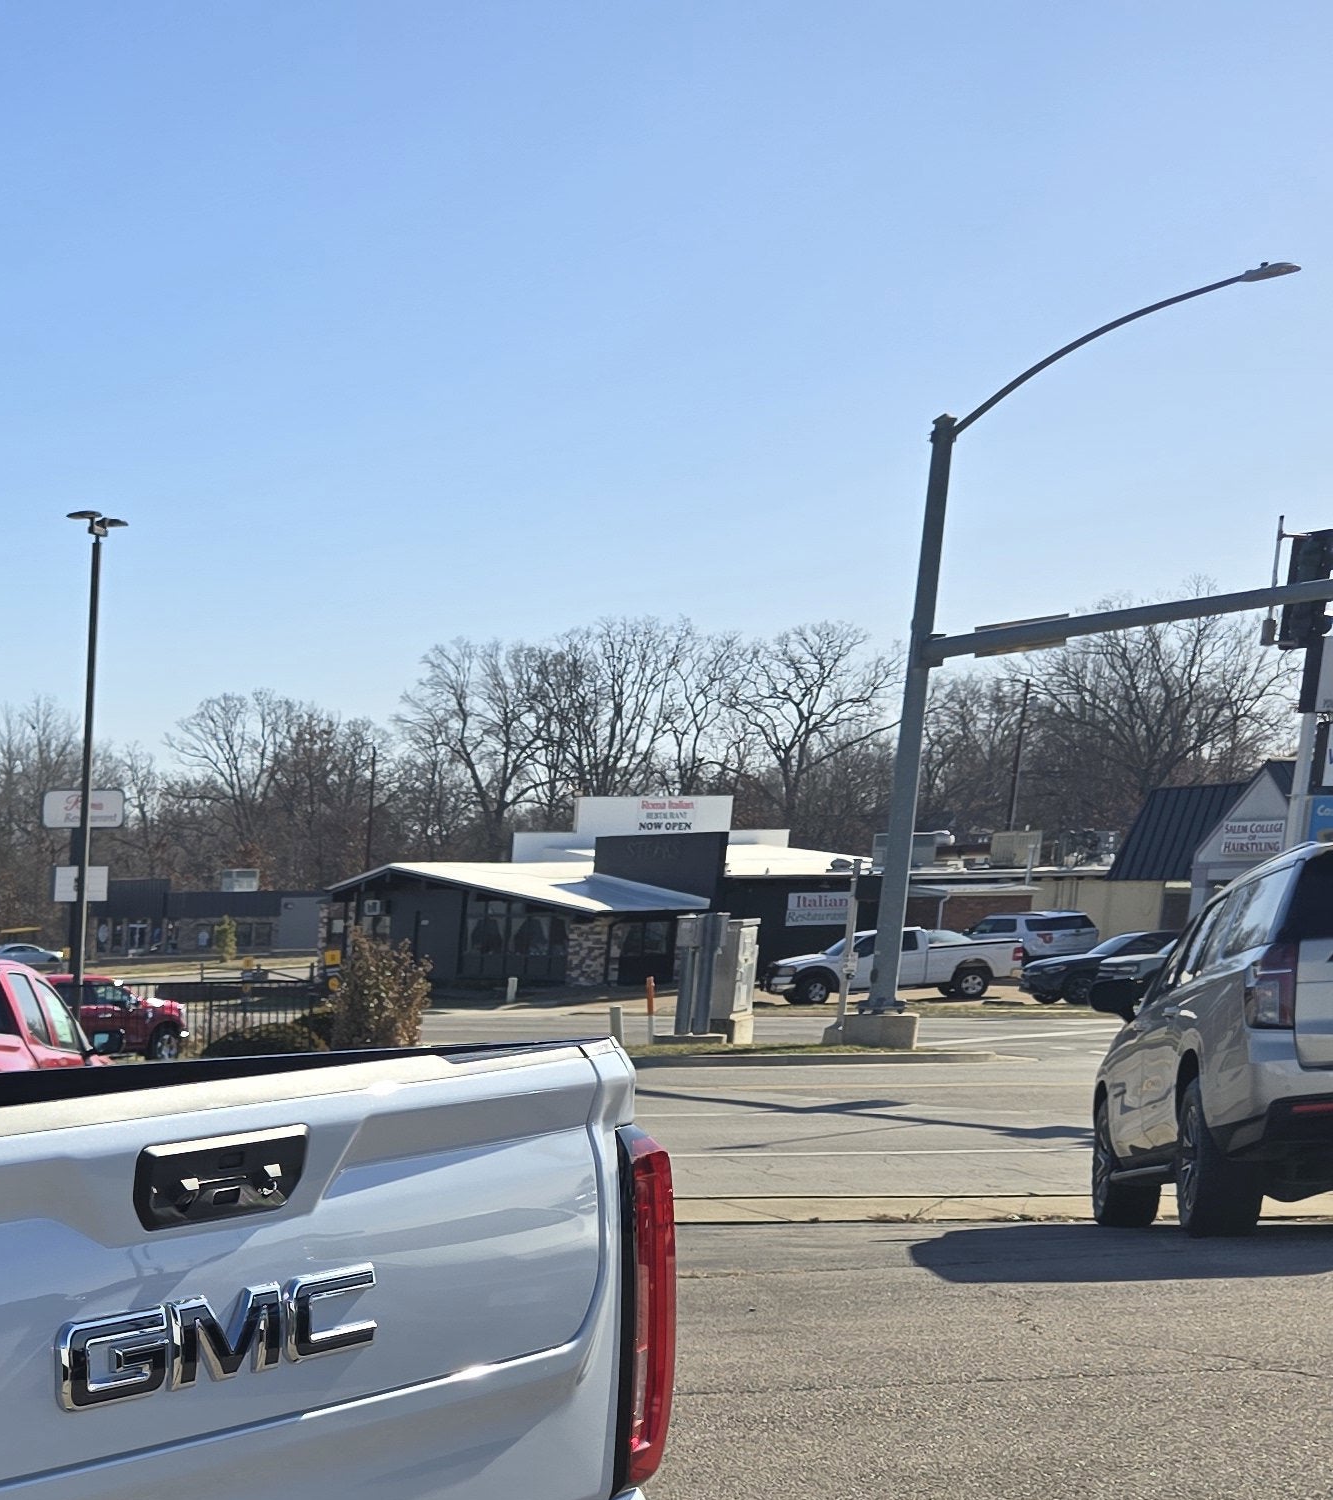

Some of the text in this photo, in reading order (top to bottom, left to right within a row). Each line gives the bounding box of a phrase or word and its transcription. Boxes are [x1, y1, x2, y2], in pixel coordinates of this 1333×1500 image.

[638, 822, 693, 831] NOW OPEN
[1224, 822, 1283, 834] SALEM COLLEGE
[1223, 841, 1280, 853] HAIRSTYLING
[796, 895, 848, 908] Italian
[55, 1262, 378, 1412] GMC
